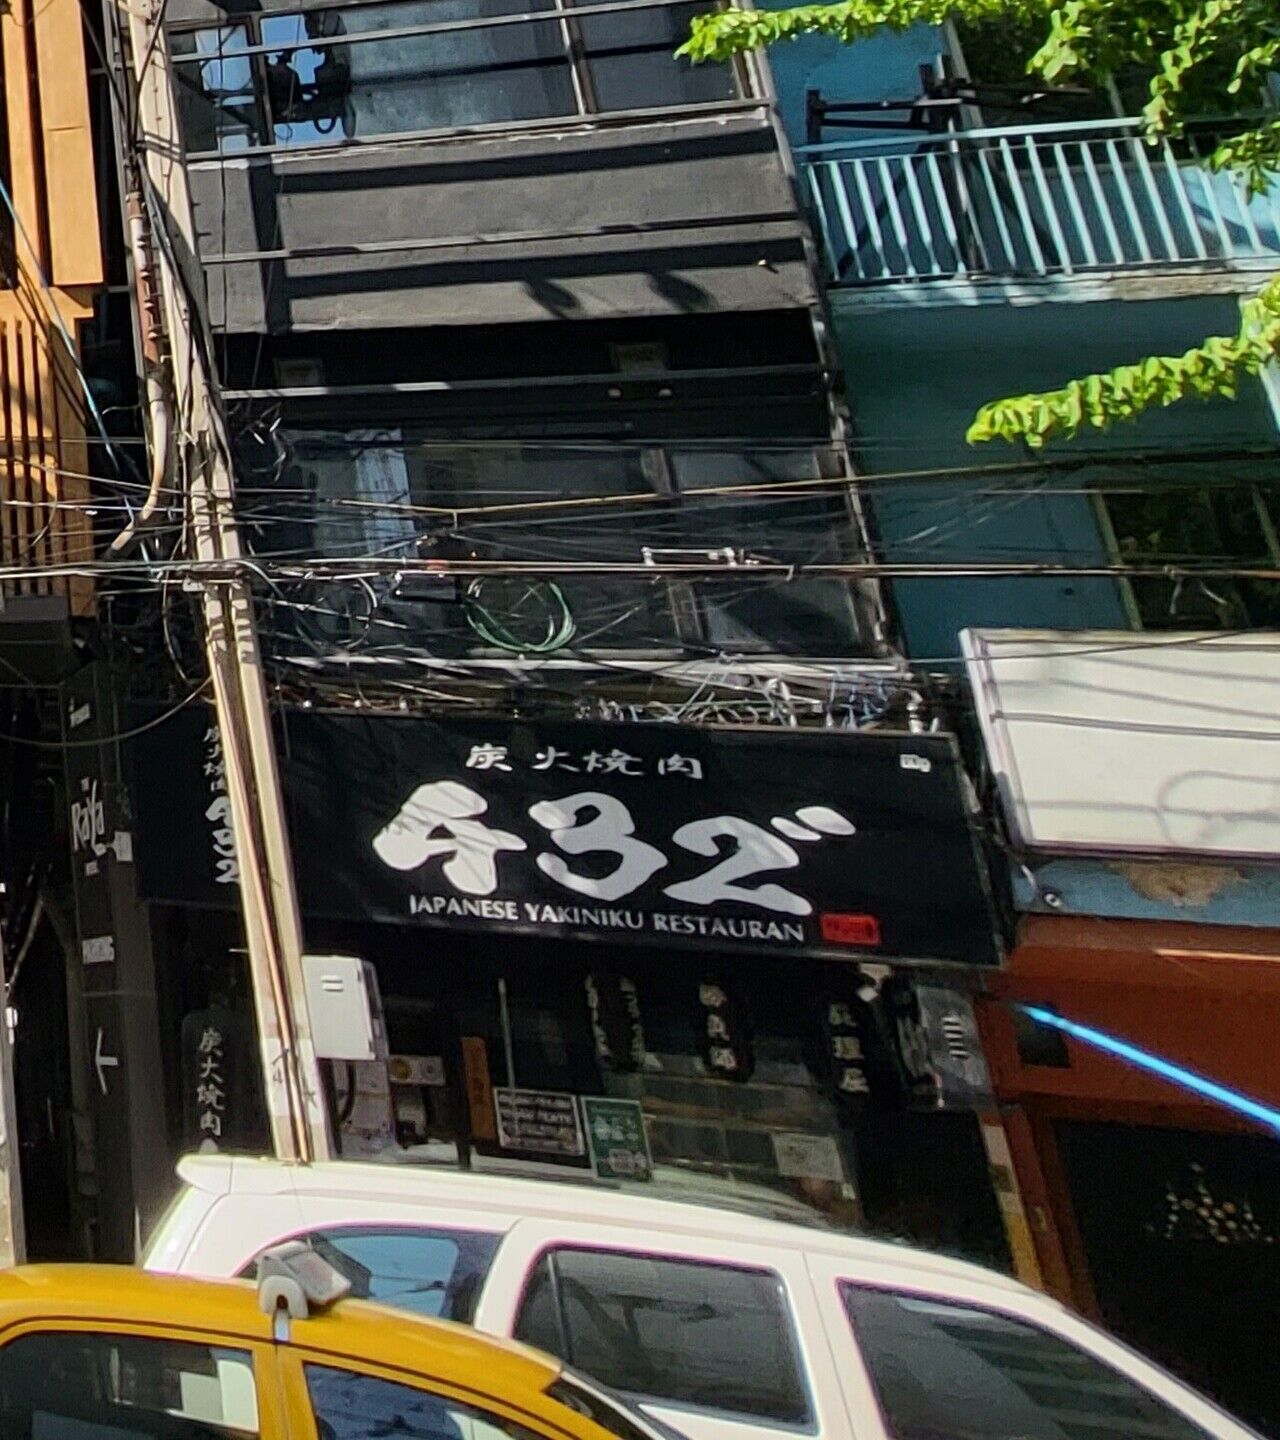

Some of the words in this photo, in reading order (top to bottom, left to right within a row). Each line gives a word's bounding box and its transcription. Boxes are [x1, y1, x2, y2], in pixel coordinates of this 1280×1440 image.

[408, 894, 519, 921] JAPANESE
[524, 903, 644, 930] YAKINIKU
[652, 912, 806, 943] RESTAURAN
